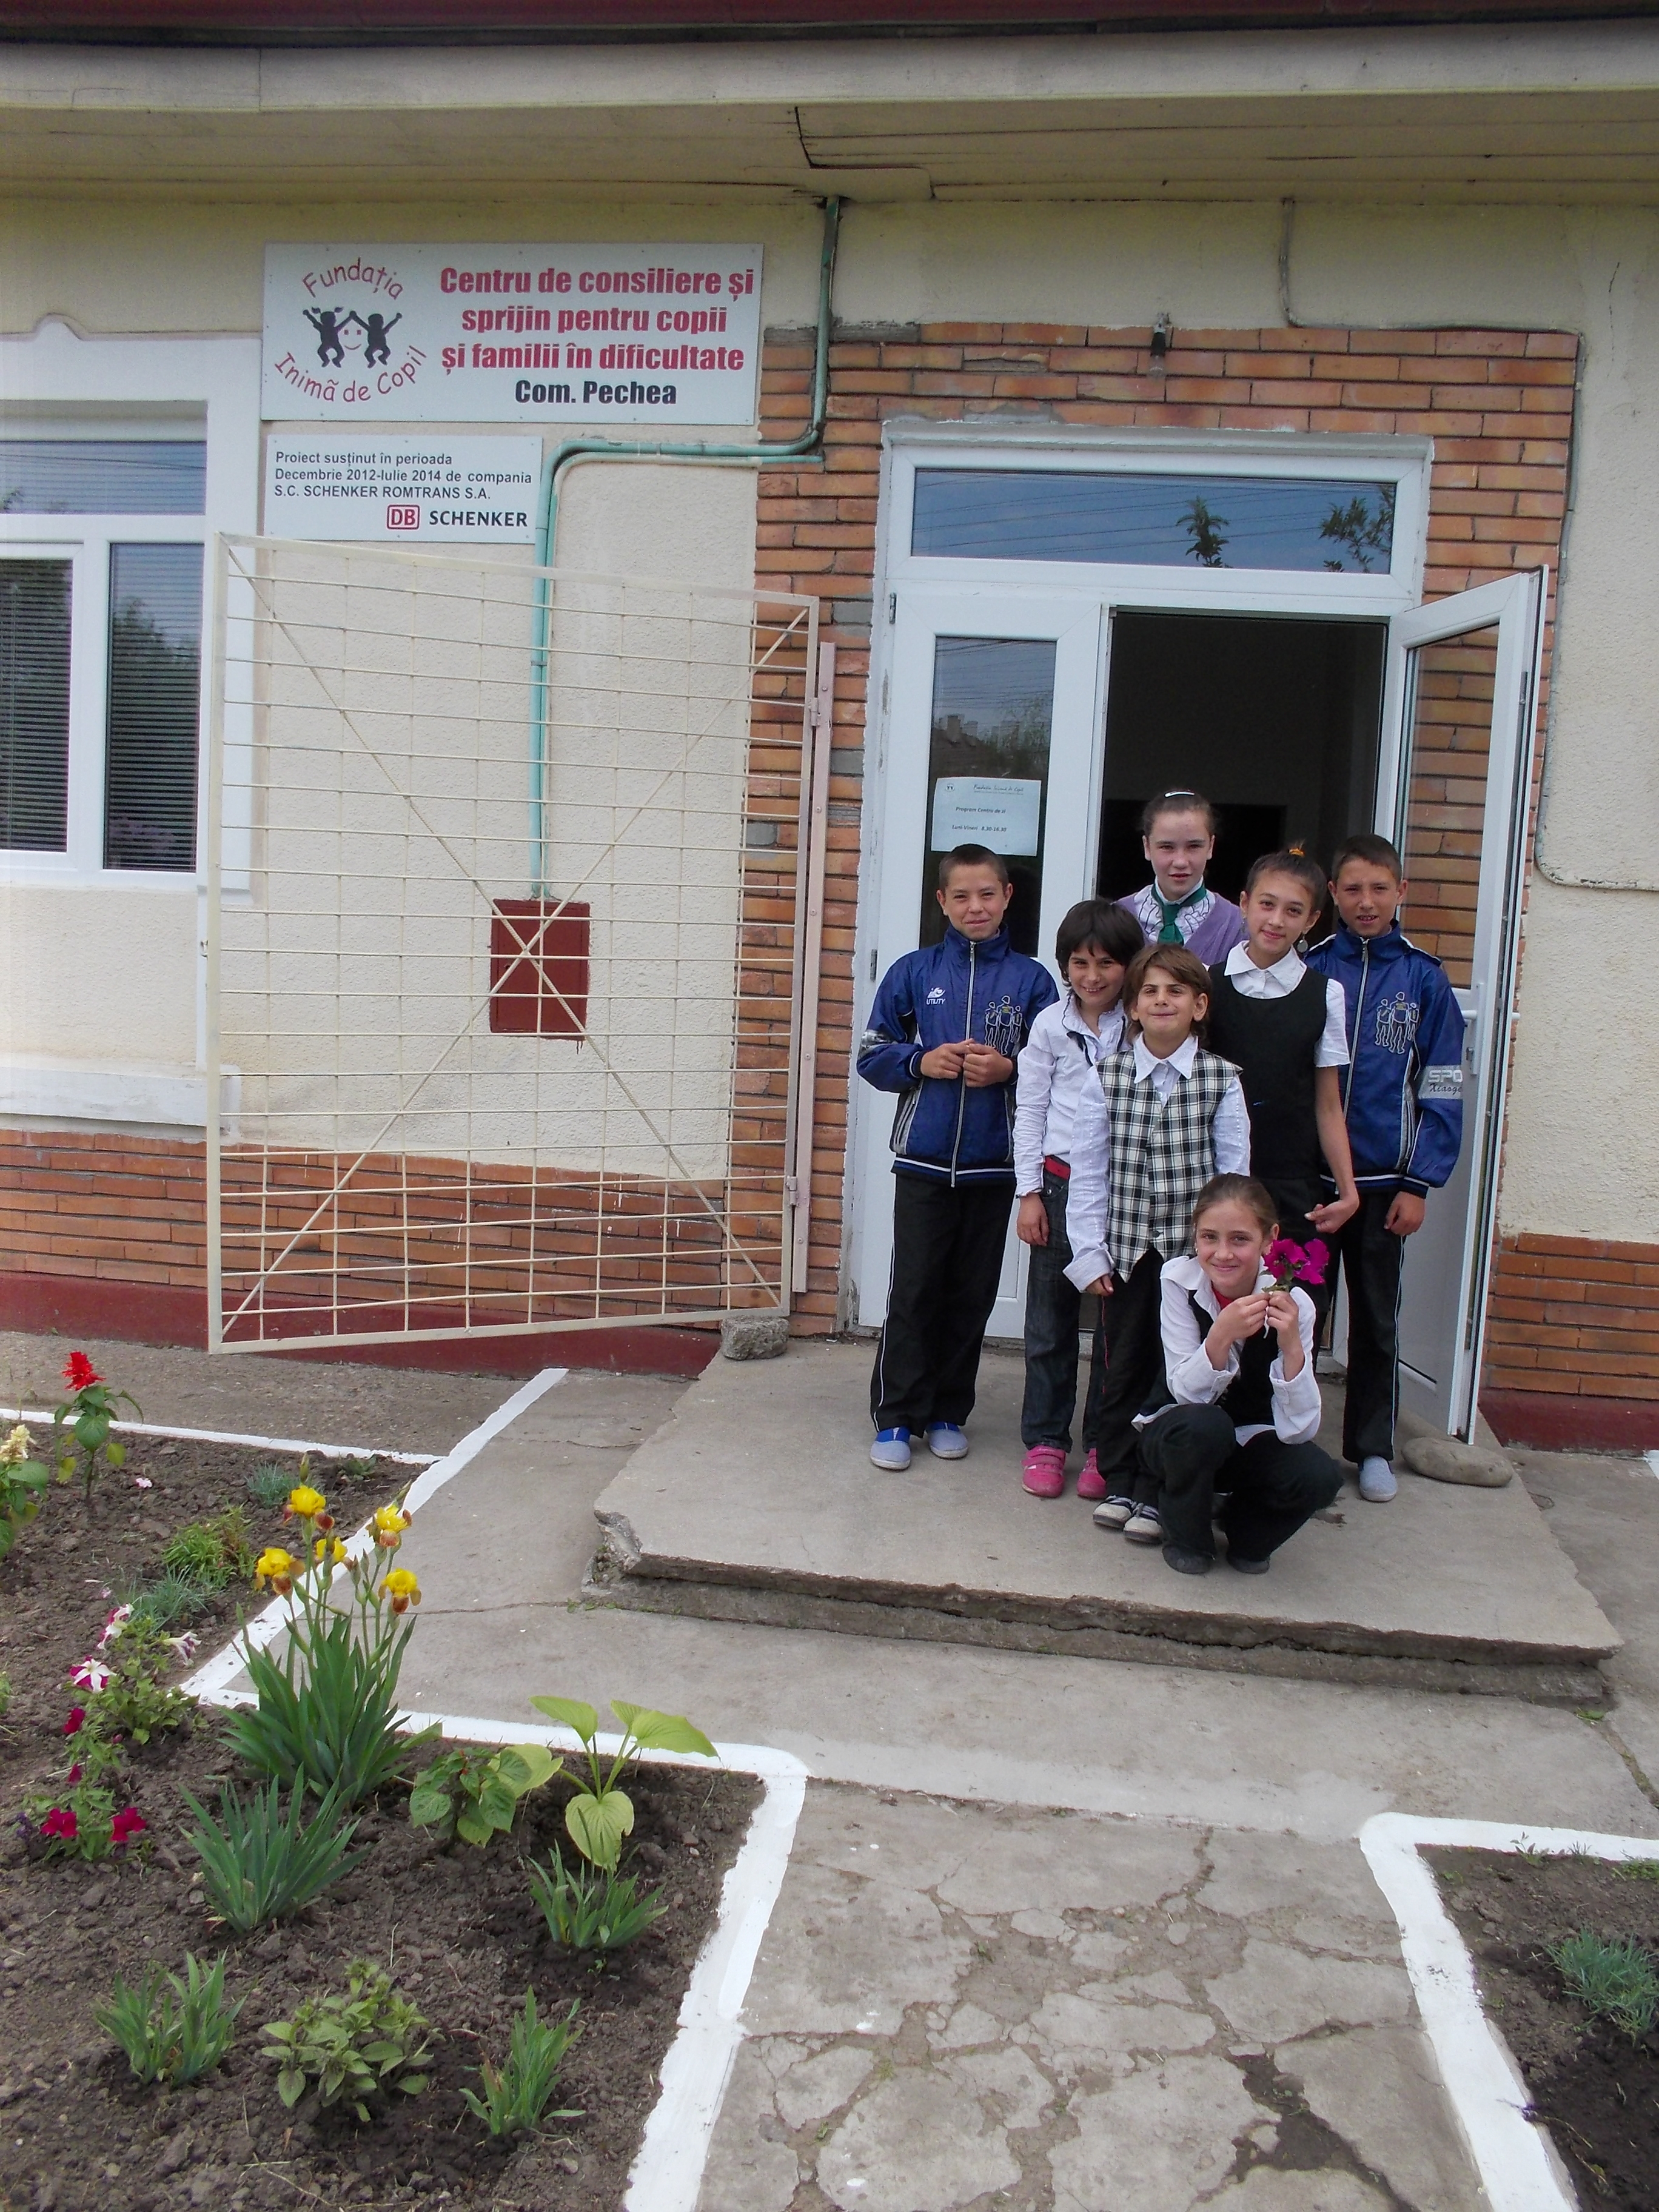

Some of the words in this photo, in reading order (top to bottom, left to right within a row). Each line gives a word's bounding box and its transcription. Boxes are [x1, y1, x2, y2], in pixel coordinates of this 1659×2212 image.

[440, 267, 532, 293] Centru
[538, 267, 572, 293] de
[578, 267, 722, 294] consiliere
[728, 268, 754, 302] și
[461, 305, 551, 333] sprijin
[557, 307, 649, 334] pentru
[656, 306, 727, 335] copii
[441, 343, 466, 375] și
[472, 343, 560, 369] familii
[565, 342, 592, 369] în
[599, 344, 744, 370] dificultate
[343, 380, 371, 403] de
[377, 344, 427, 395] Copil
[515, 380, 576, 403] Com.
[583, 380, 677, 404] Pechea
[276, 451, 321, 463] Proiect
[324, 452, 377, 468] susținut
[380, 452, 392, 464] în
[396, 452, 452, 467] perioada
[275, 468, 343, 480] Decembrie
[346, 468, 407, 481] 2012-Iulie
[412, 469, 441, 481] 2014
[446, 470, 461, 482] de
[468, 471, 532, 486] compania
[274, 484, 300, 497] S.C.
[303, 484, 378, 498] SCHENKER
[383, 486, 460, 499] ROMTRANS
[464, 487, 491, 500] S.A.
[390, 508, 417, 526] DB
[429, 510, 528, 527] SCHENKER
